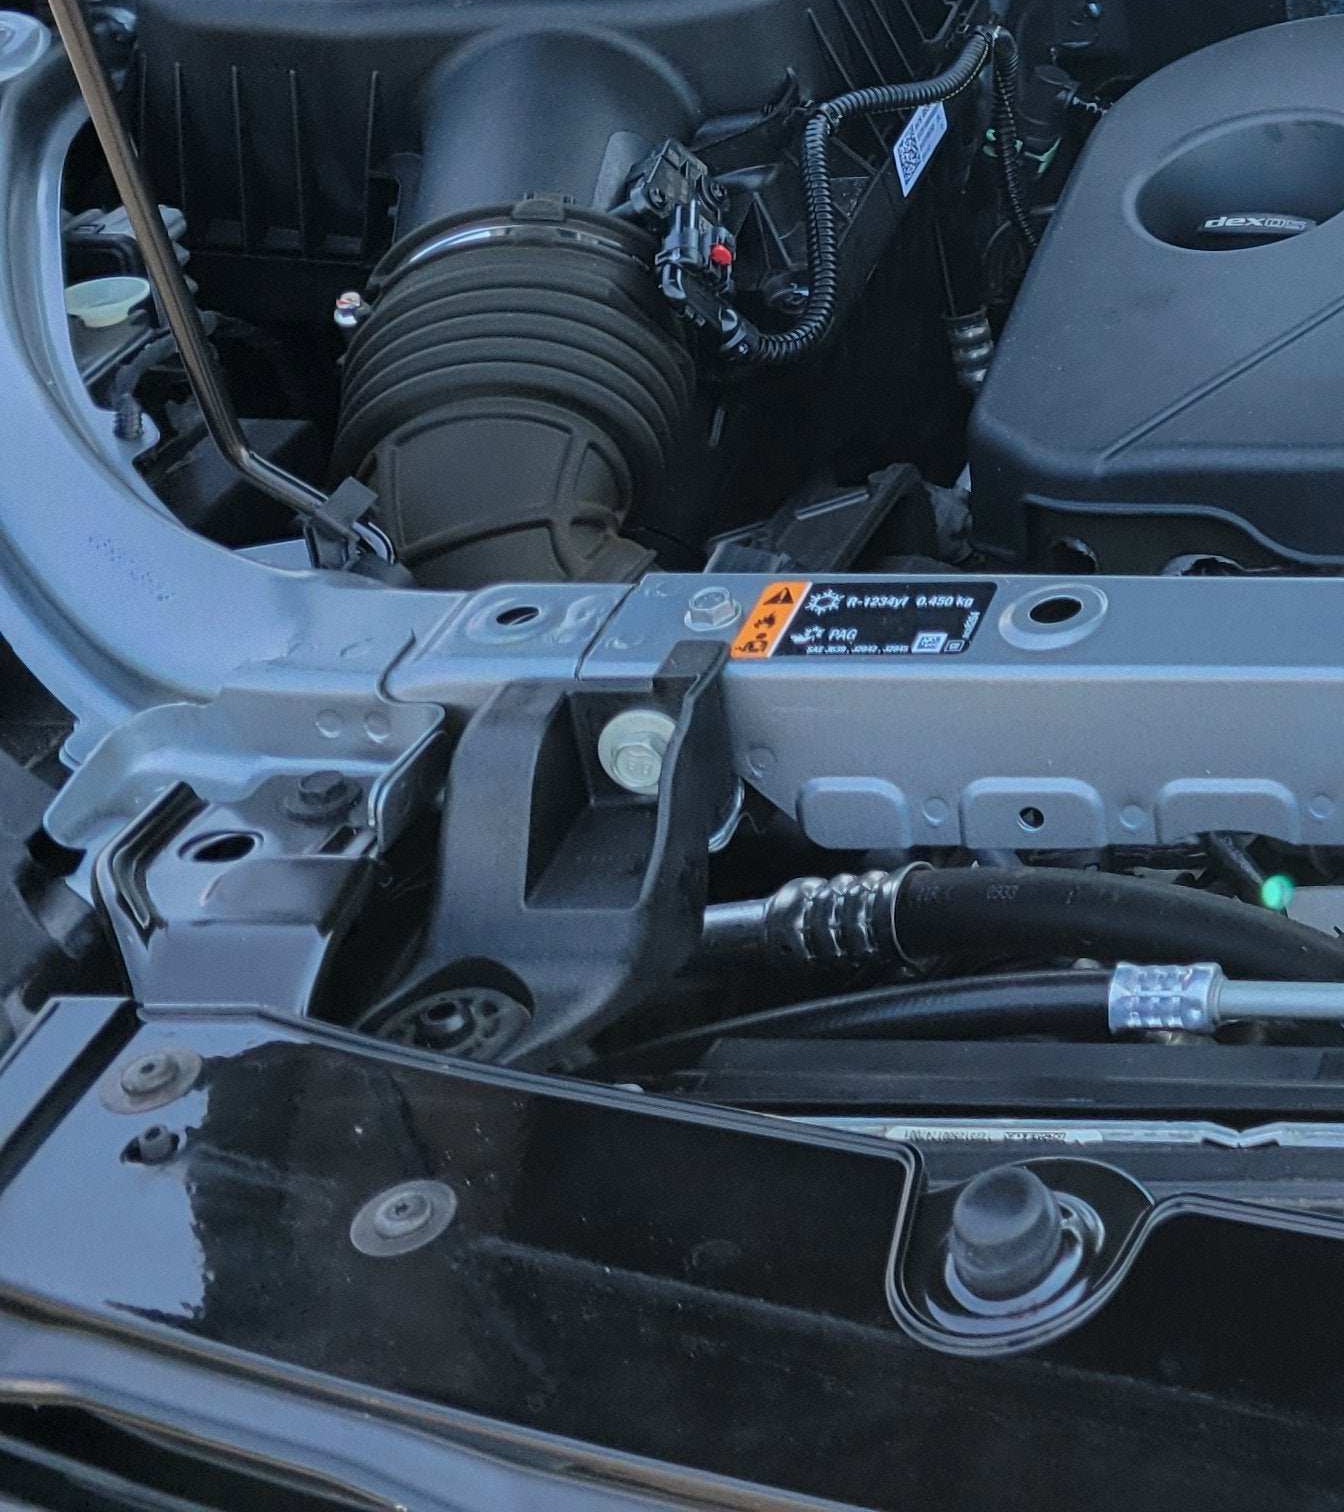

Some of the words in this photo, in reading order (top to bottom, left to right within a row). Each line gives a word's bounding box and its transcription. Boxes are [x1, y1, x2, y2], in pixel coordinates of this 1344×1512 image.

[1204, 216, 1307, 231] dexos
[846, 595, 910, 609] R-1234yf
[916, 595, 954, 608] 0.450
[956, 595, 975, 609] kg
[828, 628, 858, 640] PAG
